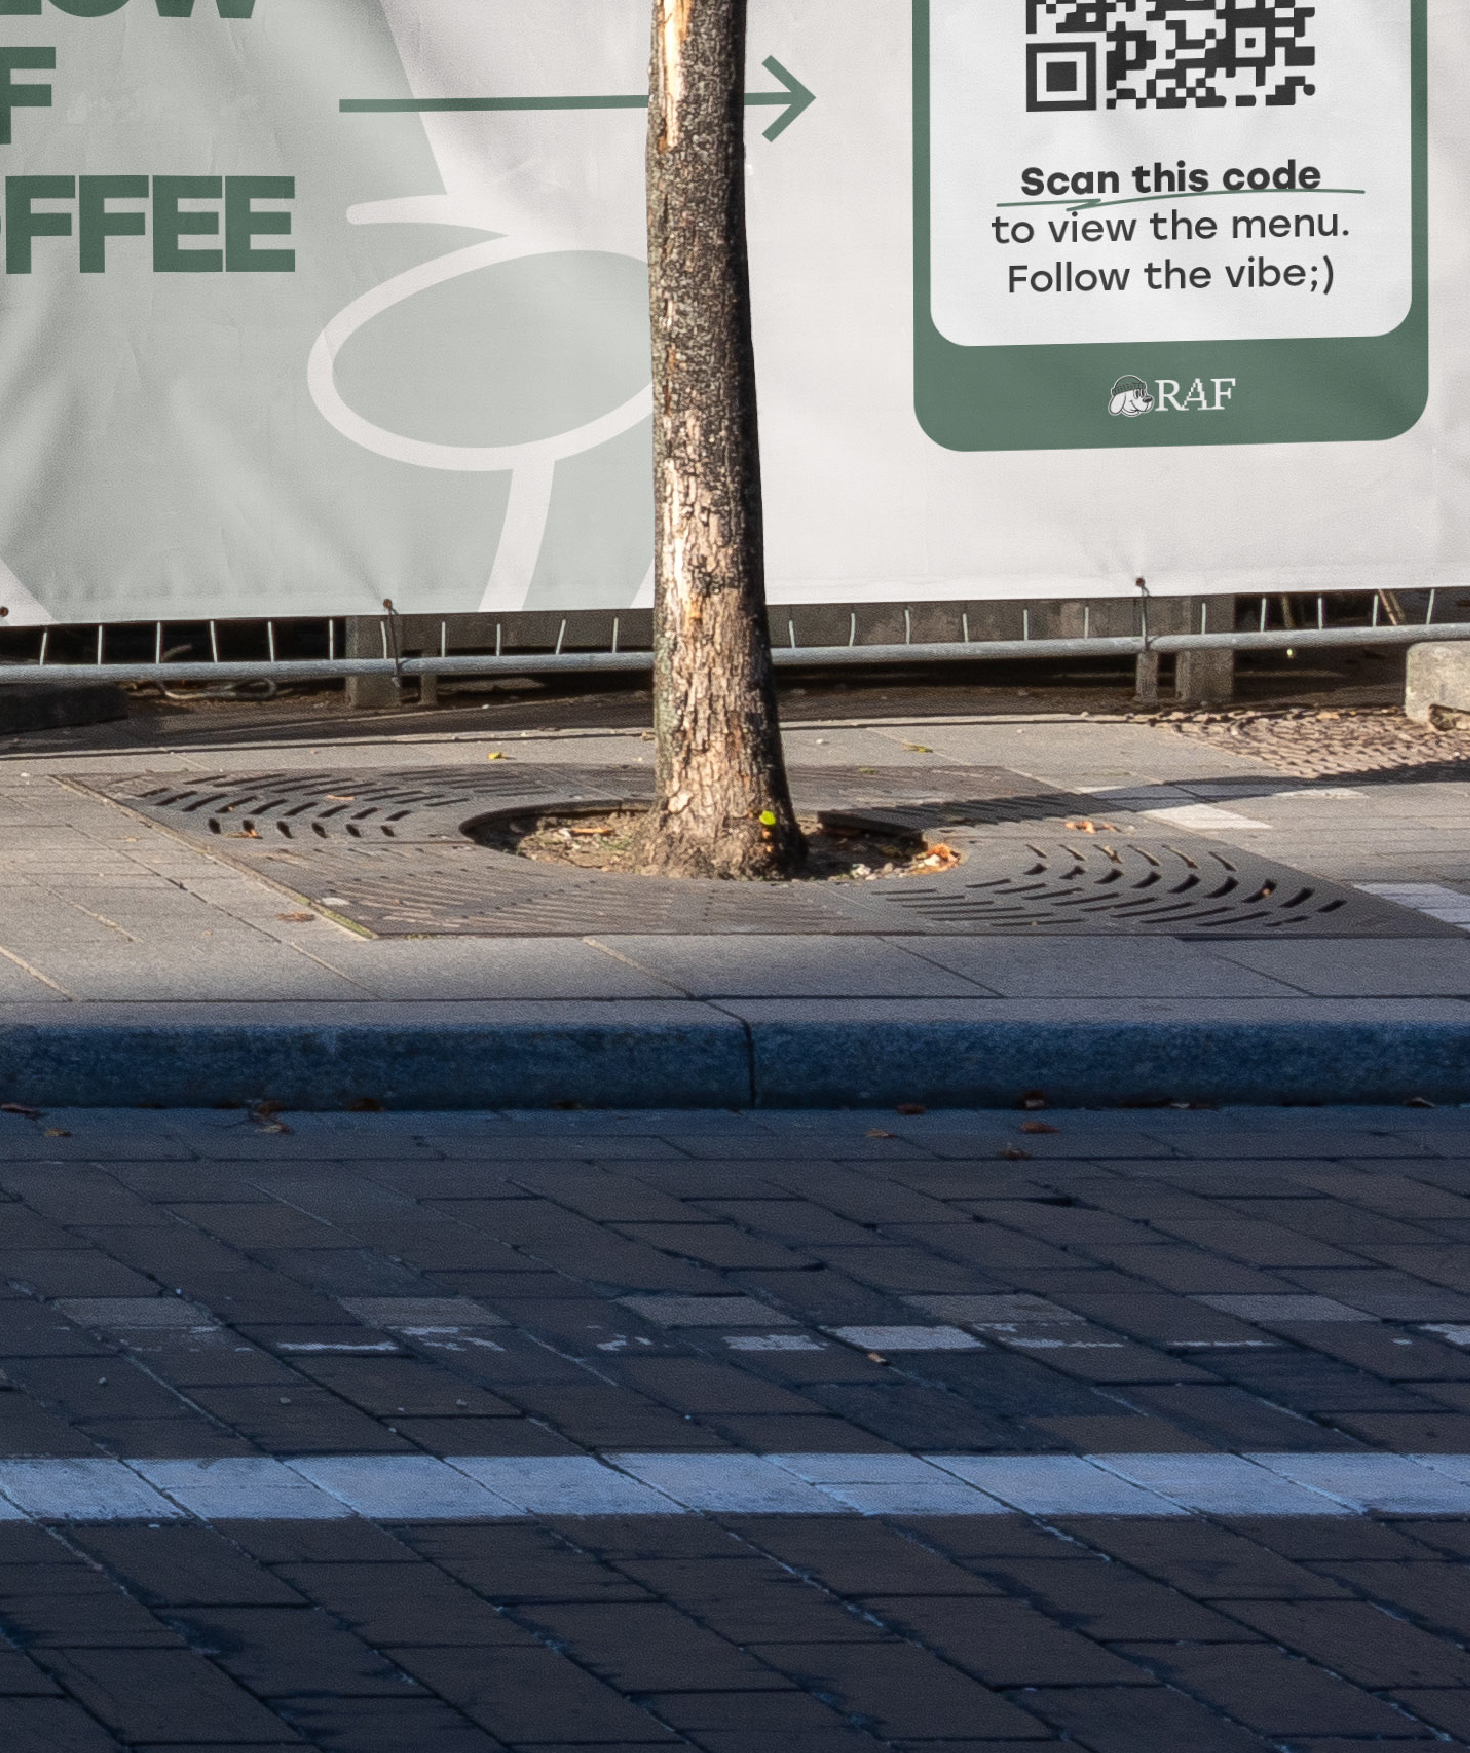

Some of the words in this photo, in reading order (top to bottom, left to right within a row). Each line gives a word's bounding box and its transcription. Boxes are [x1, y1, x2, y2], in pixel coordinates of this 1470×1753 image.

[1020, 166, 1120, 197] Scan
[1131, 159, 1210, 194] this
[1222, 158, 1322, 191] code
[991, 214, 1035, 244] to
[1048, 210, 1137, 243] view
[1149, 208, 1218, 241] the
[1231, 212, 1350, 240] menu.
[1008, 260, 1131, 293] Follow
[1144, 258, 1212, 290] the
[1224, 253, 1335, 296] vibe;)
[1154, 377, 1236, 412] RAF
